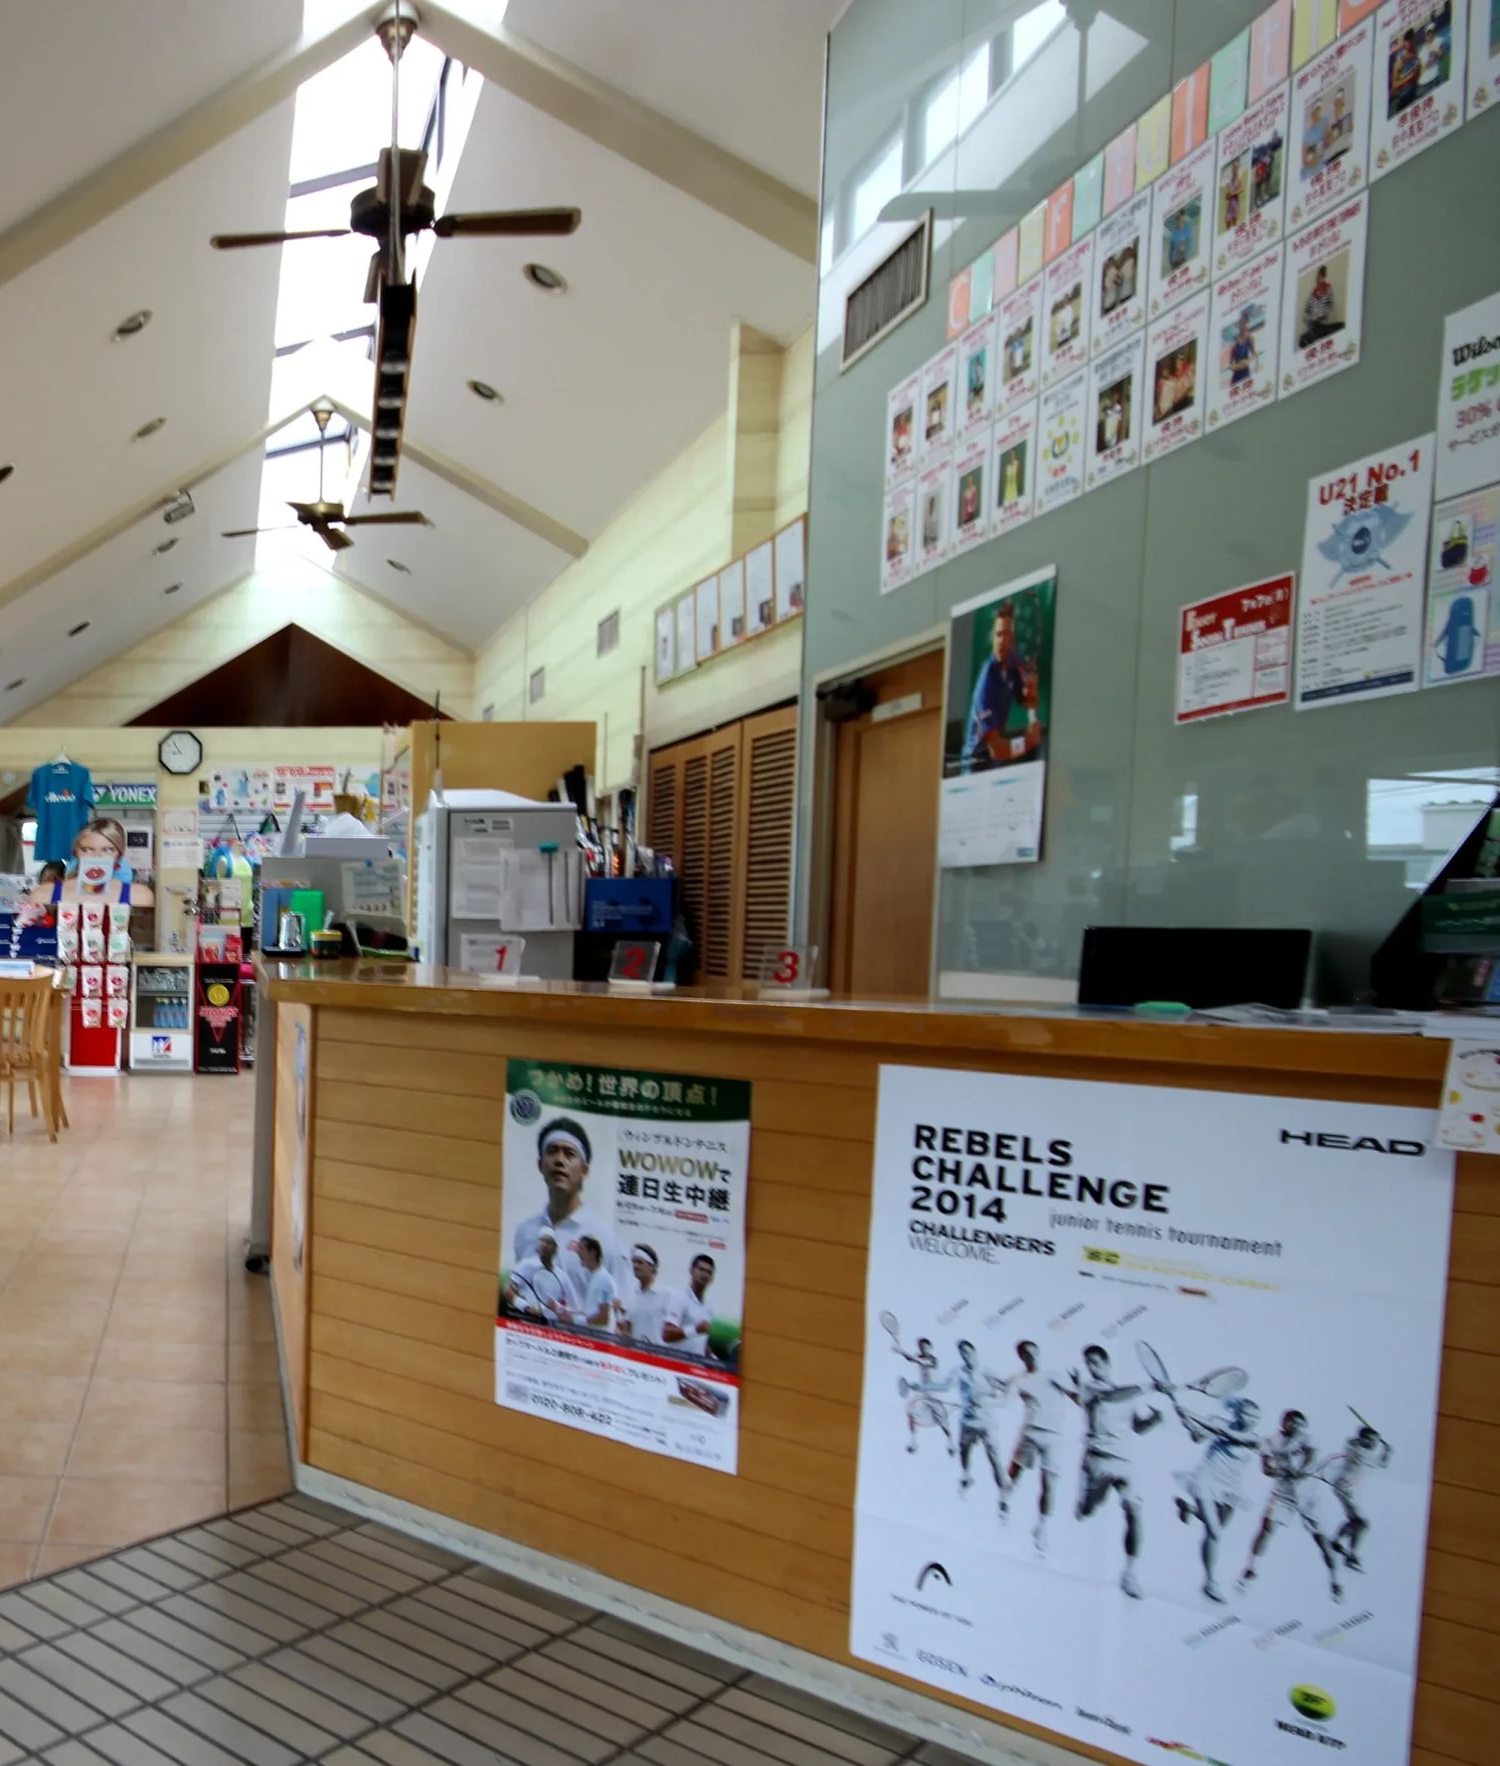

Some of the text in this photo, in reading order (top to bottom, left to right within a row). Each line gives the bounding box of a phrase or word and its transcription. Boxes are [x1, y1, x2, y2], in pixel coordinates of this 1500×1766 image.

[1319, 472, 1358, 506] U21
[109, 784, 157, 803] YONEX
[494, 945, 508, 972] 1
[620, 946, 647, 979] 2
[773, 950, 801, 984] 3
[914, 1124, 1074, 1167] REBELS
[1279, 1129, 1426, 1158] HEAD
[617, 1174, 732, 1213] 連日生中継
[911, 1156, 1171, 1214] CHALLENGE
[910, 1186, 1007, 1224] 2014
[909, 1218, 1056, 1258] CHALLENGERS
[1049, 1210, 1284, 1258] junior tennis tournament
